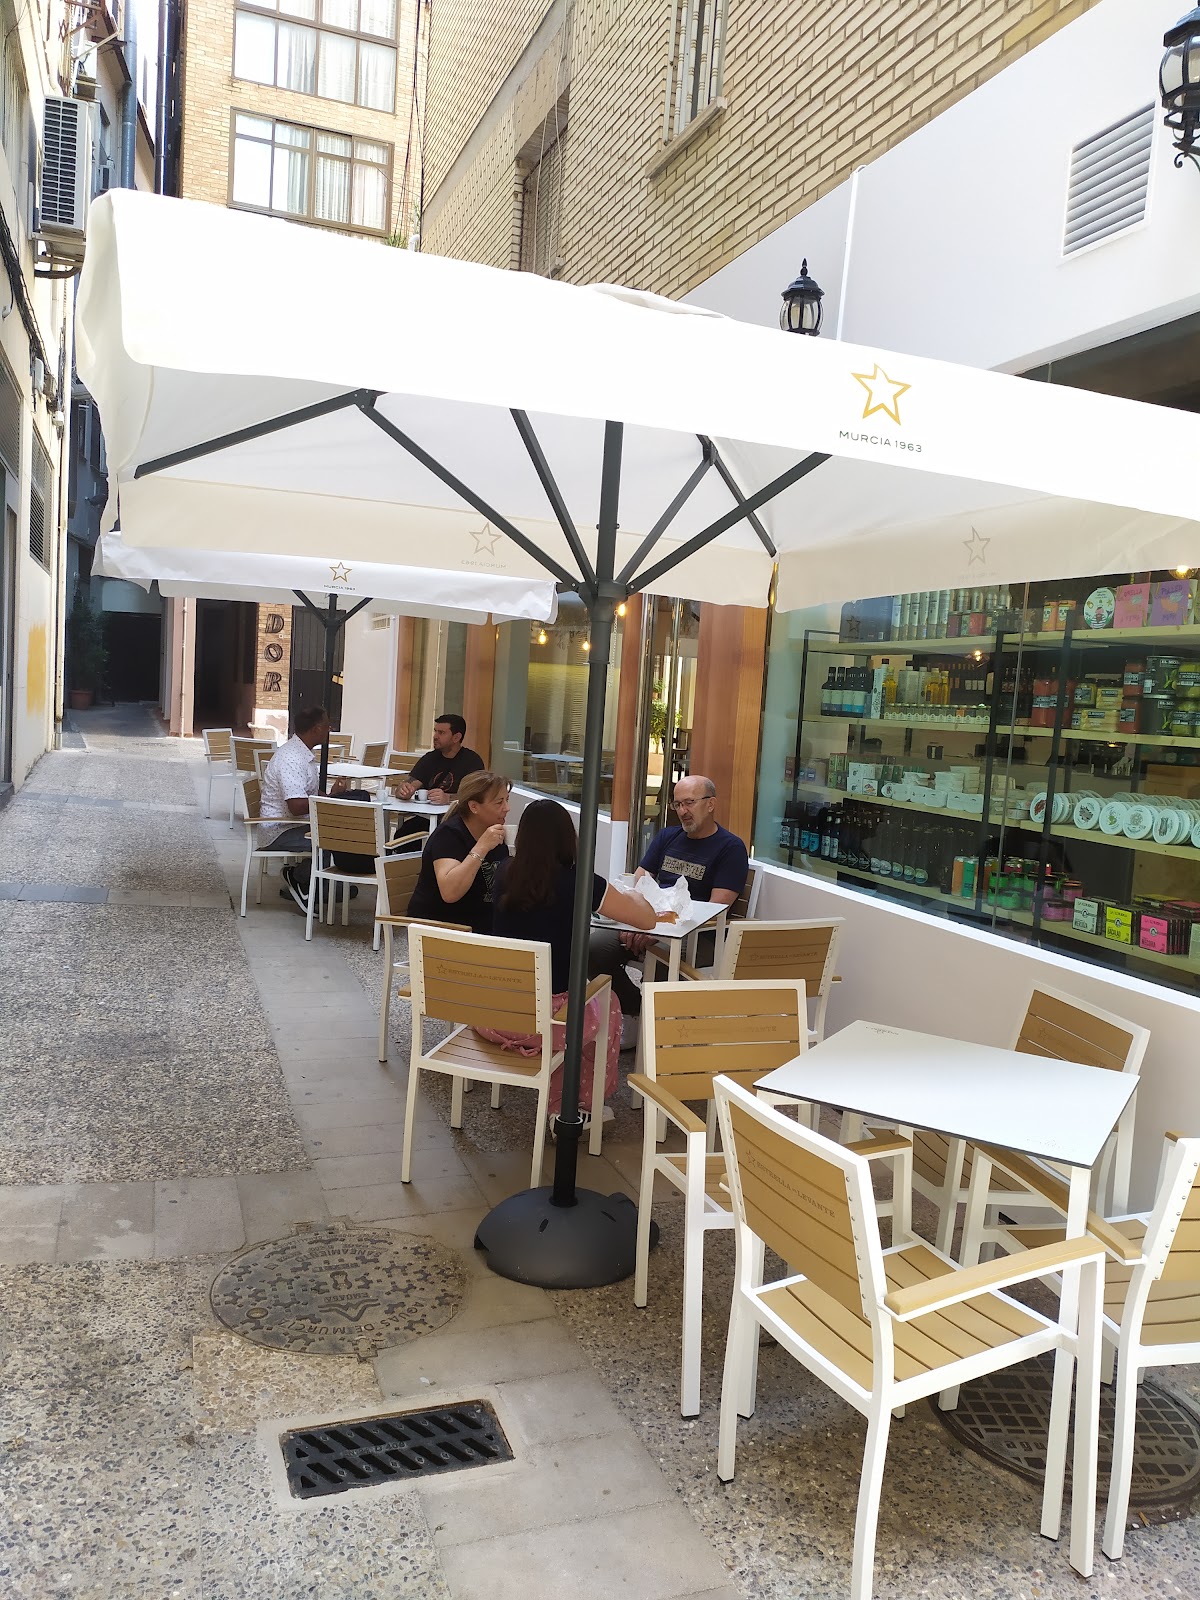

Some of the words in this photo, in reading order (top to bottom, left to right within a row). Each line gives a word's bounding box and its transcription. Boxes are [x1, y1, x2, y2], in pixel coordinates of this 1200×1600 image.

[839, 430, 892, 447] MURCIA
[895, 440, 922, 453] 1963
[756, 1161, 792, 1191] ESTRELLA
[797, 1190, 836, 1218] LEVANTE
[295, 1248, 382, 1263] SANEAMIENTO
[380, 1301, 425, 1327] AGUAS
[276, 1317, 346, 1335] MURCIA
[354, 1323, 375, 1333] DE
